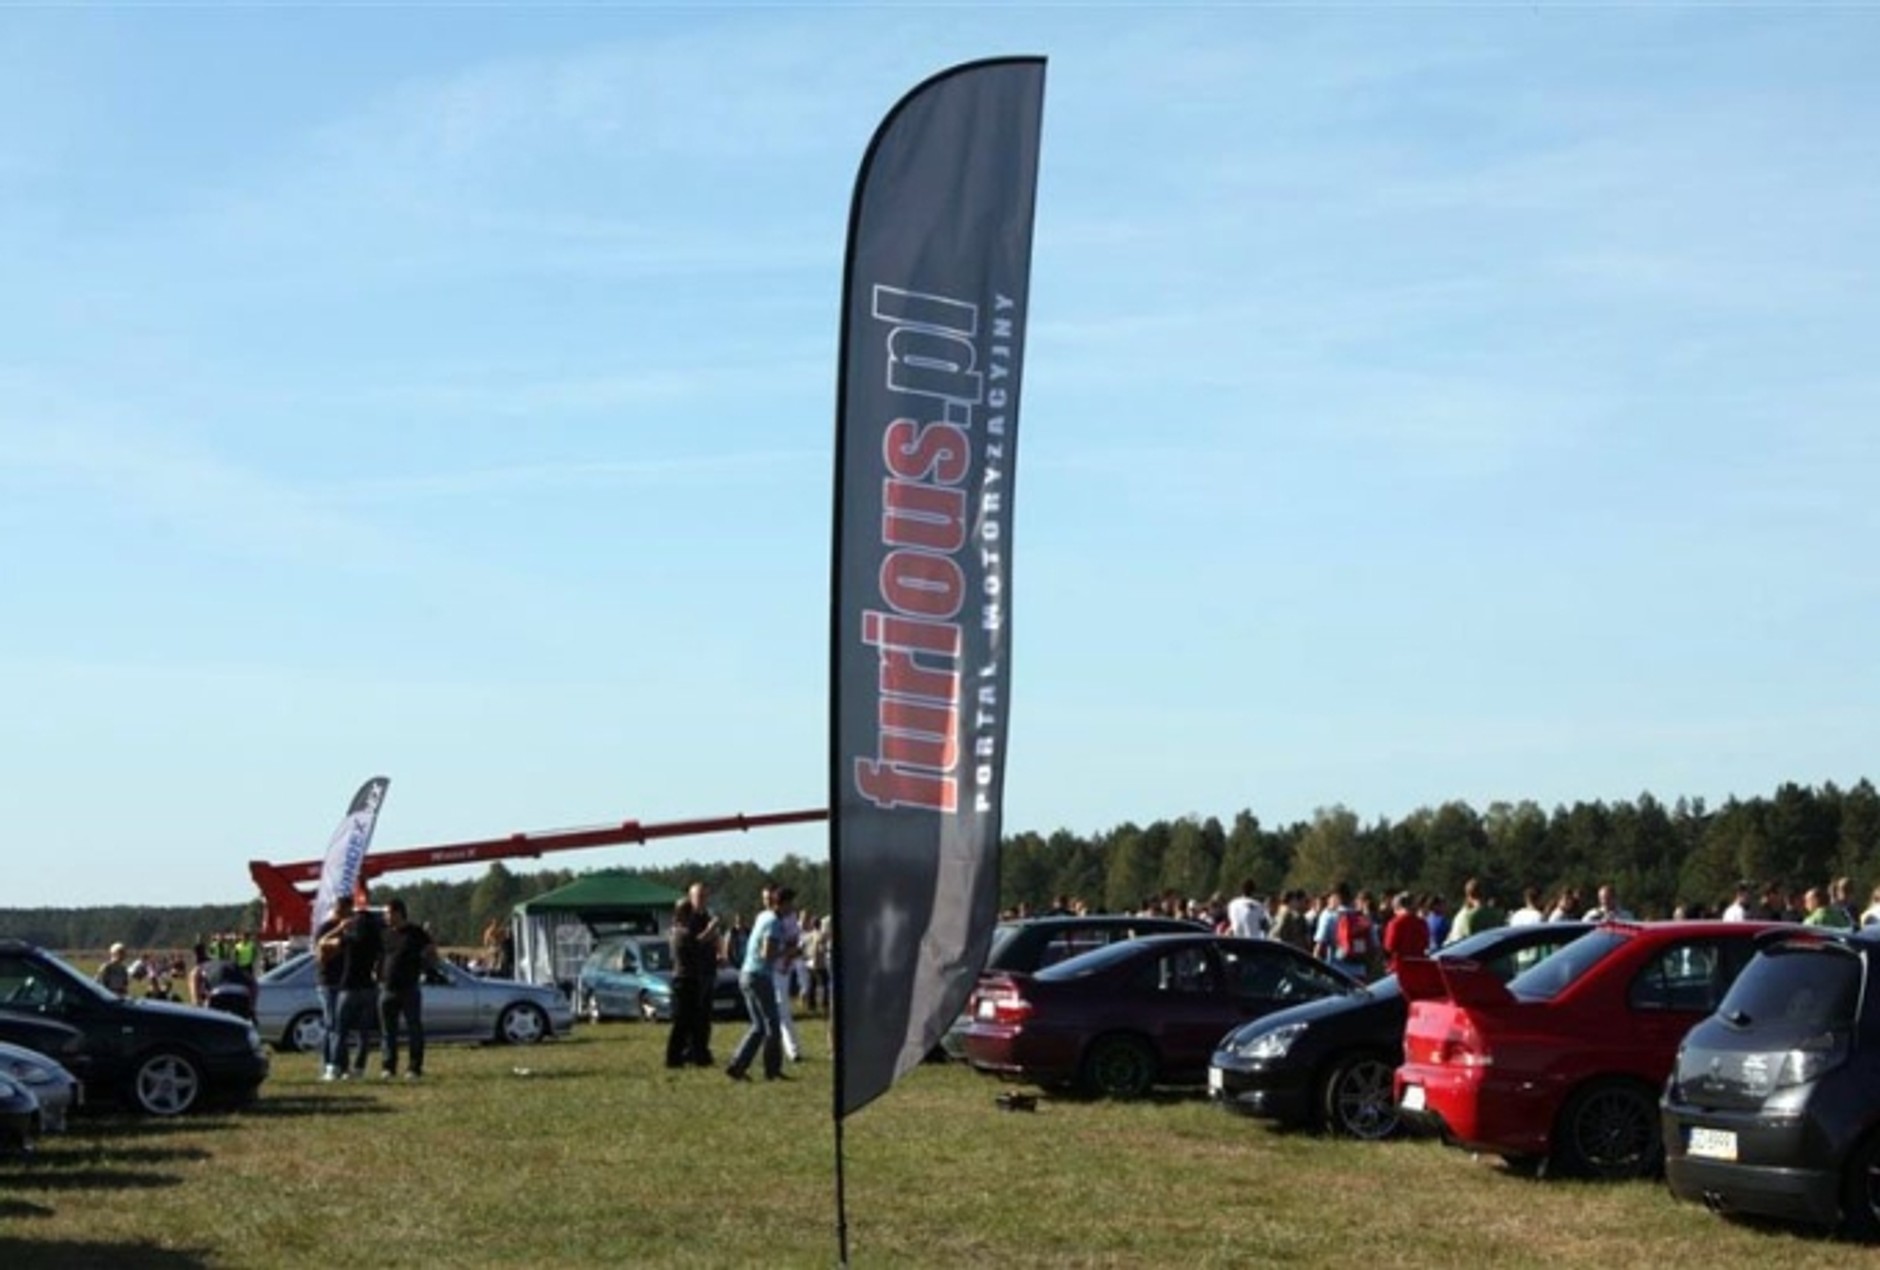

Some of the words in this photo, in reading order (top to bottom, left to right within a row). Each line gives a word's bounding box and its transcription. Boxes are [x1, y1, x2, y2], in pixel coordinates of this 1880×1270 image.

[855, 284, 983, 814] furious.pl
[981, 293, 1014, 630] MOTORYZACYJNY
[975, 661, 997, 812] PORTAL
